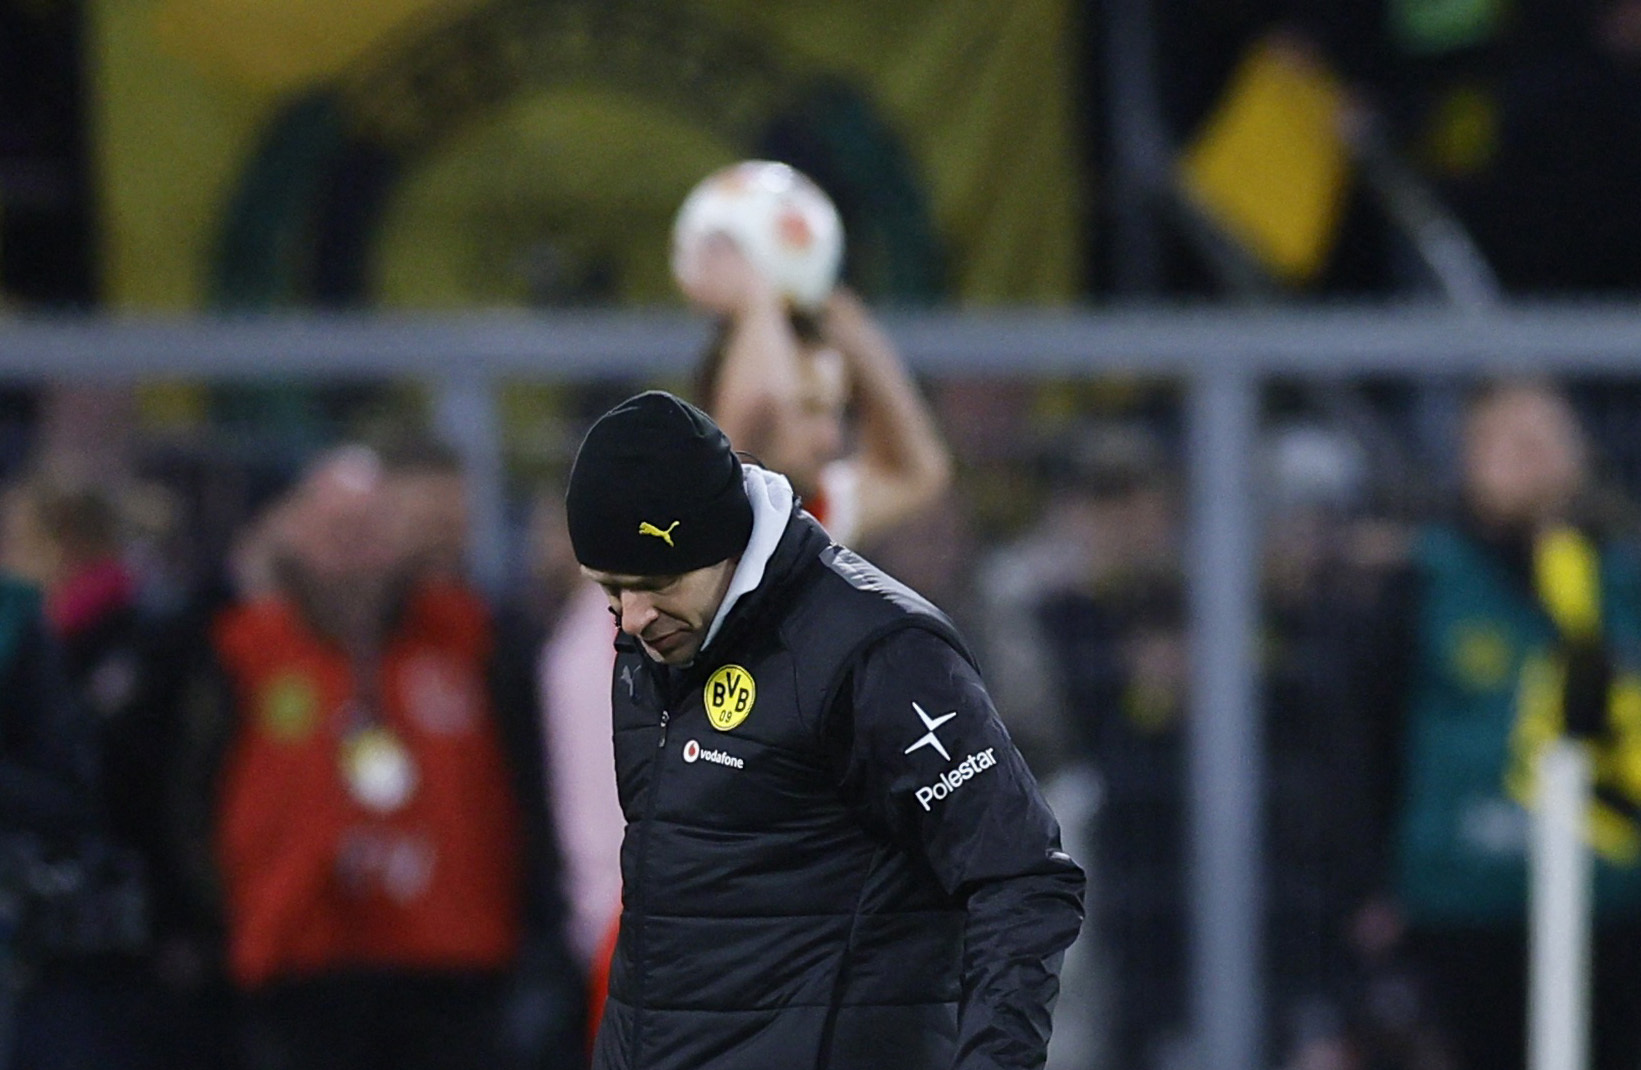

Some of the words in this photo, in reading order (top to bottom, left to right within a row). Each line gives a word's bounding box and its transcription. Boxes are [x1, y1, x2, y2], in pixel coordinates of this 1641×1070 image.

[713, 671, 750, 713] BVB
[719, 709, 732, 724] 09
[700, 748, 744, 769] vodafone
[915, 745, 997, 811] Polestar
